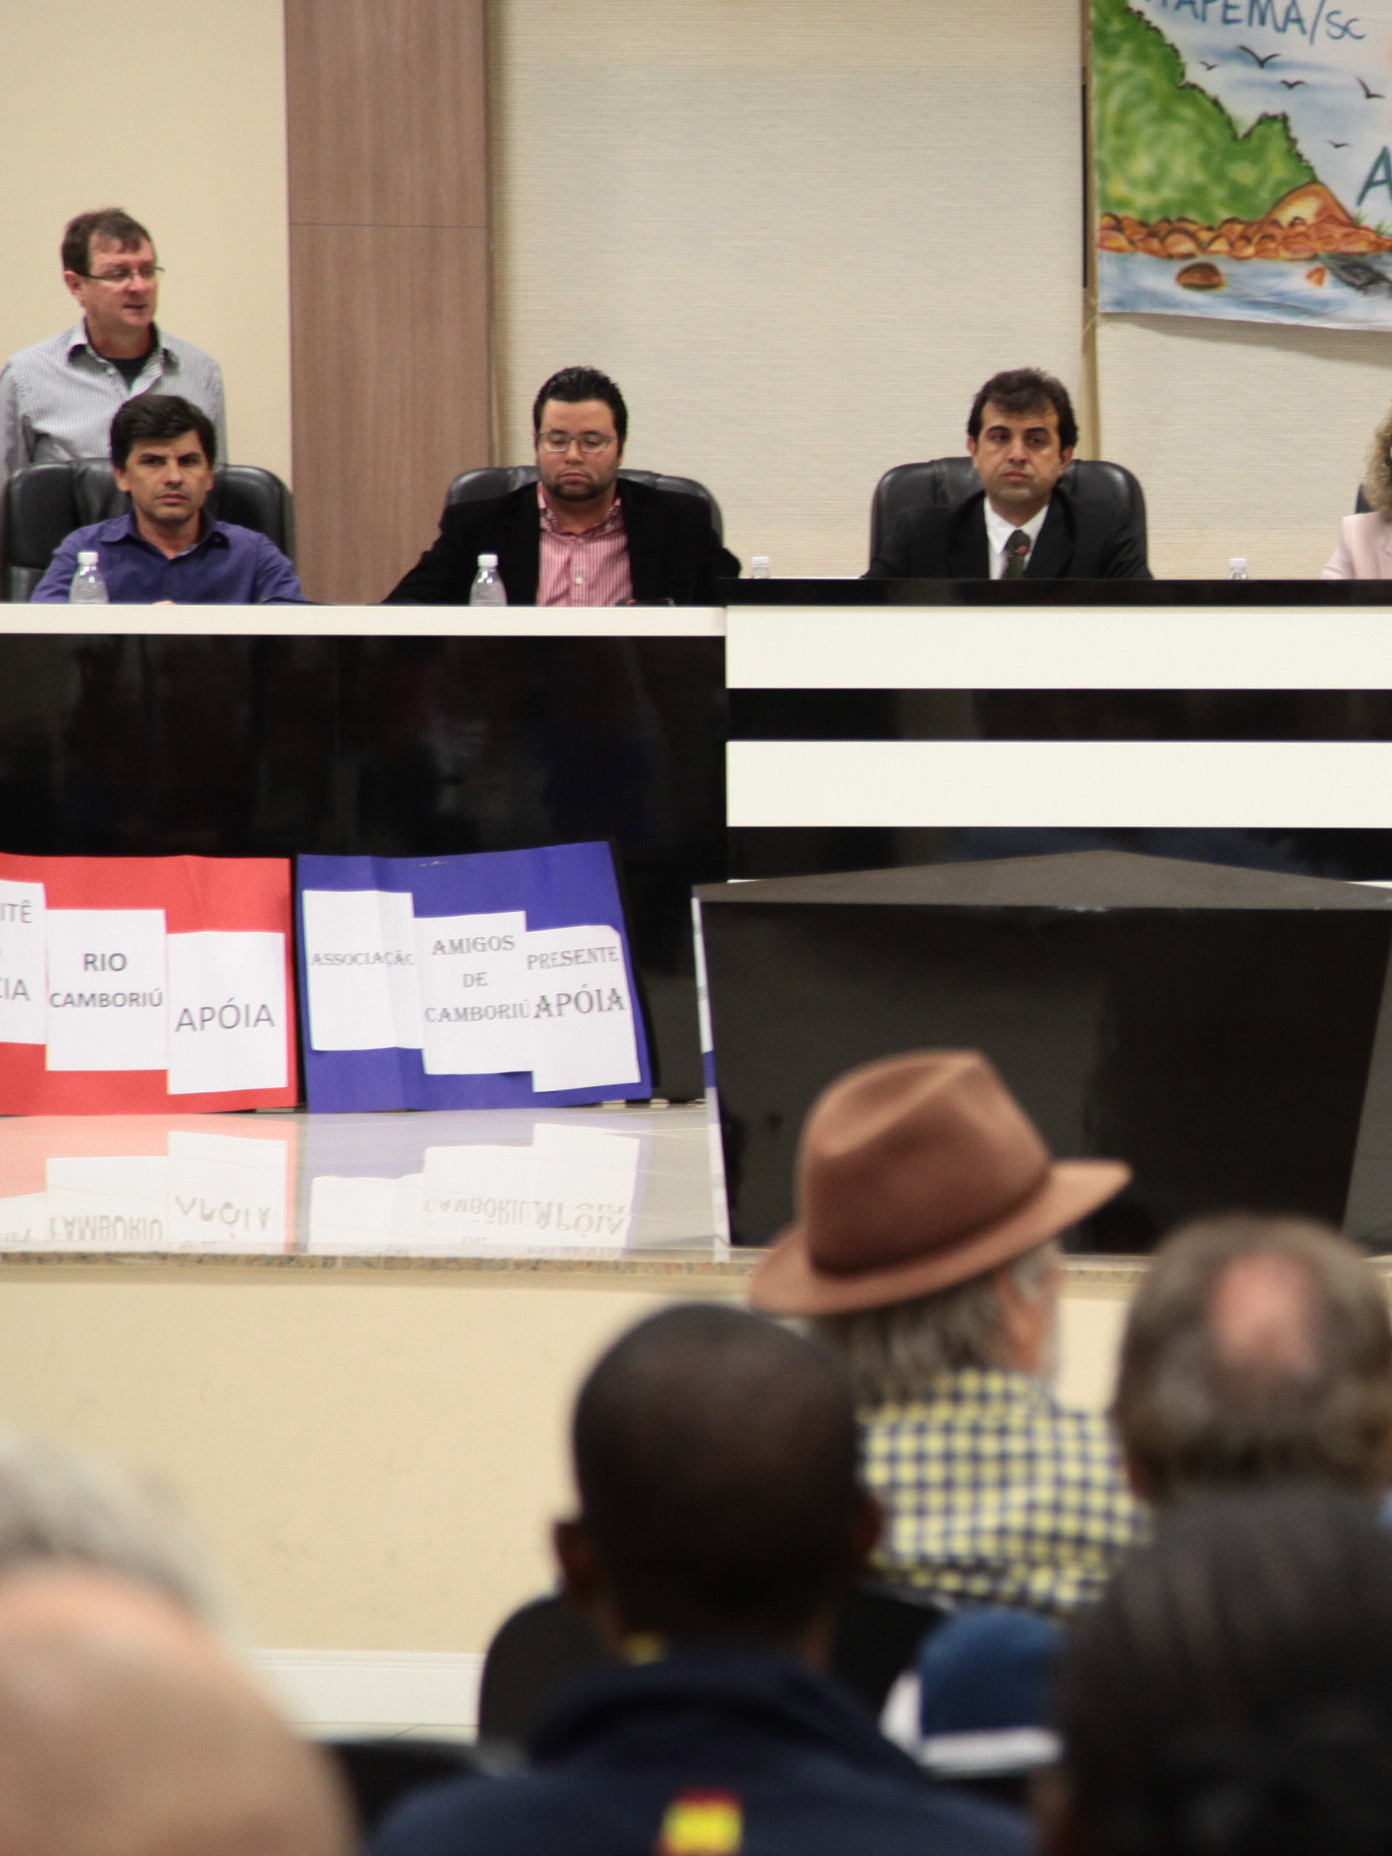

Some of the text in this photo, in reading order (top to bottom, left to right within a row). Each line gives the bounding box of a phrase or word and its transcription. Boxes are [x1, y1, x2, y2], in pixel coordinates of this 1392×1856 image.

[431, 935, 515, 956] AMIGOS
[83, 953, 128, 972] RIO
[527, 945, 620, 971] PRESENTE
[463, 971, 488, 988] DE
[50, 988, 163, 1008] CAMBORIÚ
[531, 982, 626, 1019] APÓIA
[175, 998, 275, 1033] APÓIA
[424, 999, 532, 1023] CAMBORIÚ
